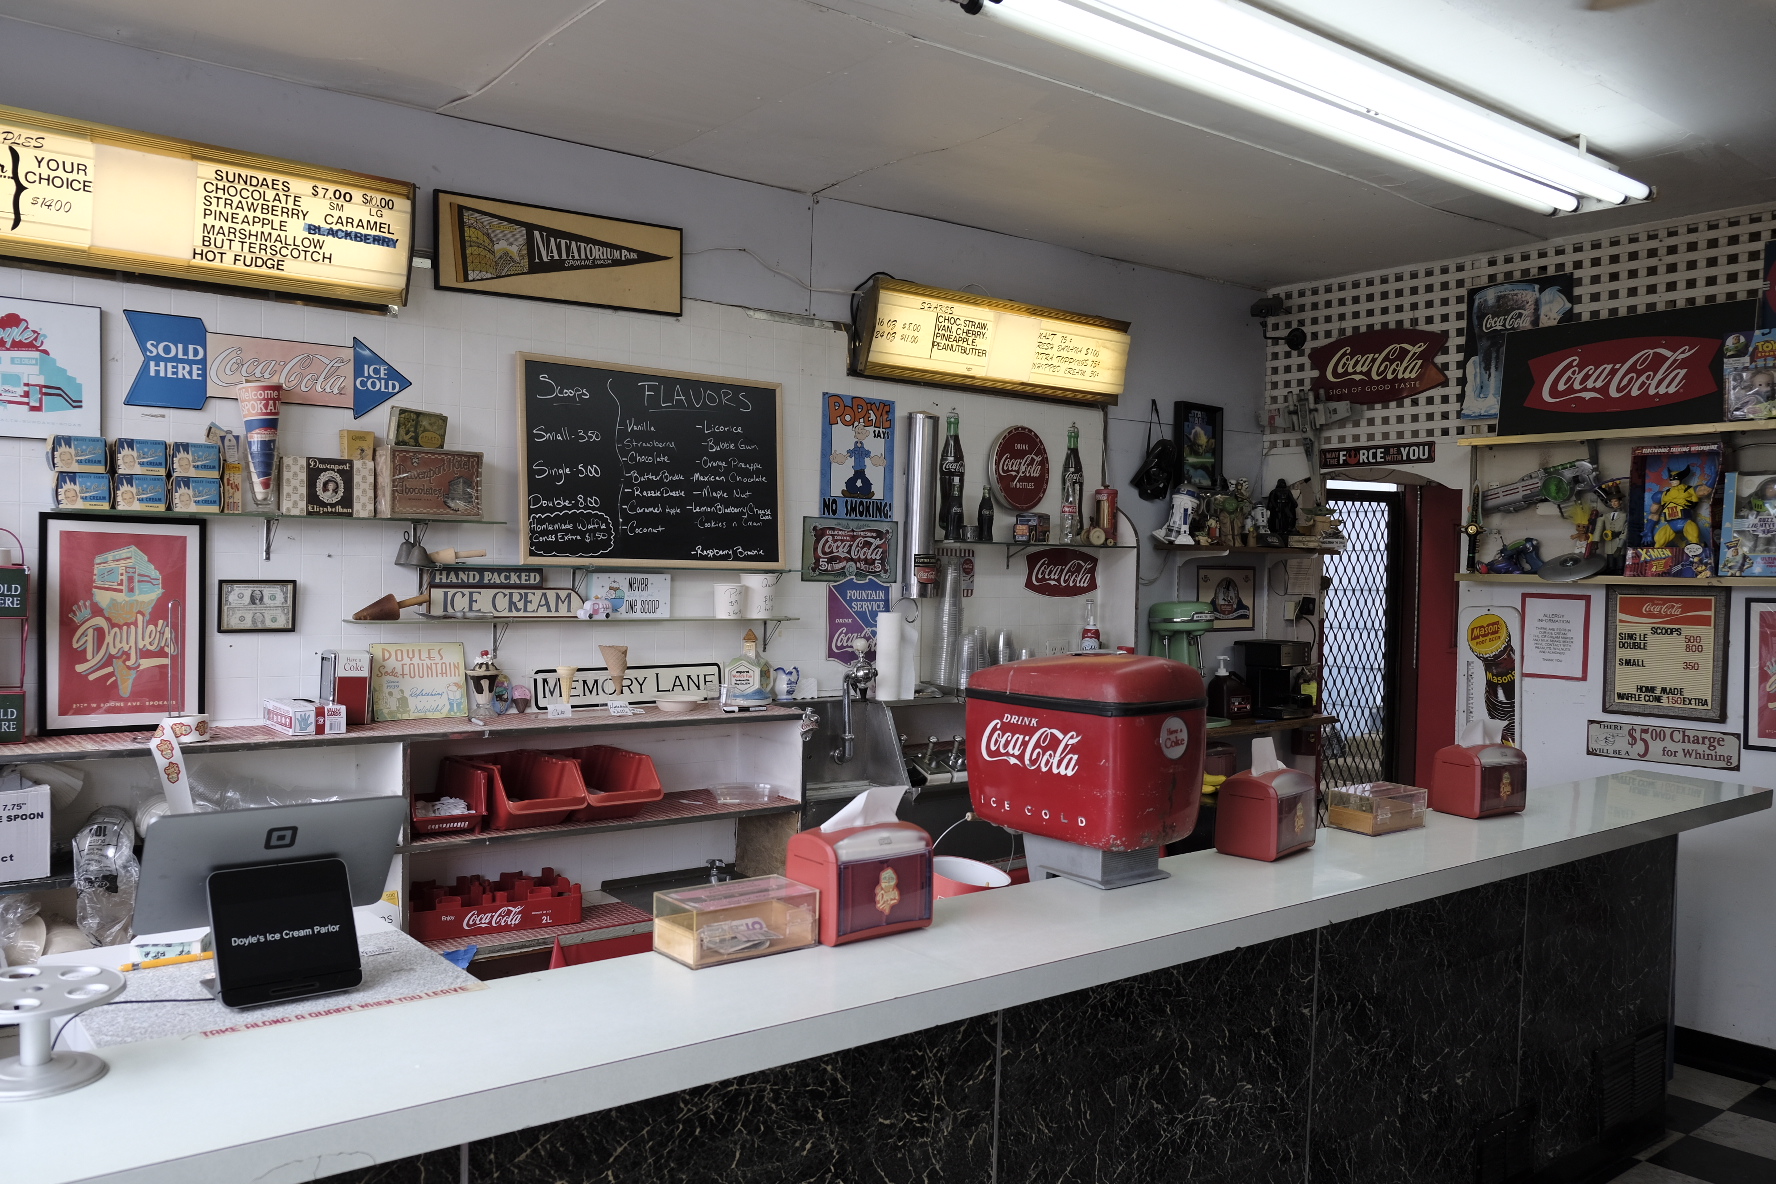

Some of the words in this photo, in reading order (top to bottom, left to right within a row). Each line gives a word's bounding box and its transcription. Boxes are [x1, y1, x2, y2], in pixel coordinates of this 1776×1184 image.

[34, 155, 88, 176] YOUR
[24, 171, 93, 193] CHOICE
[214, 170, 290, 192] SUNDAES
[312, 185, 353, 203] $7.00
[203, 182, 302, 207] CHOCOLATE
[203, 195, 309, 221] STRAWBERRY
[324, 213, 395, 235] CARAMEL
[328, 202, 344, 212] SM
[369, 208, 383, 218] LG
[203, 208, 288, 232] PINEAPPLE
[307, 223, 399, 248] BLACKBERRY
[203, 223, 325, 250] MARSHMALLOW
[202, 236, 333, 263] BUTTERSCOTCH
[533, 230, 621, 262] NATATORIUM
[193, 248, 226, 263] HOT
[233, 254, 285, 271] FUDGE
[877, 317, 884, 327] 16
[1482, 308, 1532, 333] Coca-Cola
[146, 340, 204, 361] SOLD
[933, 341, 988, 357] PEANUTBUTTER
[1326, 342, 1430, 382] Coca-Cola
[150, 361, 203, 381] HERE
[210, 346, 352, 396] Coca-Cola
[364, 364, 388, 377] ICE
[1541, 344, 1701, 403] Coca-Cola
[356, 377, 400, 393] COLD
[536, 374, 590, 401] Scoops
[1365, 384, 1391, 392] GOOD
[1394, 380, 1421, 389] TASTE
[240, 387, 278, 400] Welcome
[638, 382, 752, 411] FLAVORS
[828, 395, 892, 429] POPEYE
[626, 417, 656, 432] Vanilla
[704, 420, 743, 434] Licorice
[533, 426, 570, 442] Small
[873, 429, 890, 439] SAYS
[708, 438, 736, 452] Bubble
[738, 438, 759, 450] Gum
[1014, 443, 1029, 451] DRINK
[1389, 447, 1398, 455] BE
[627, 451, 670, 464] Chocolate
[1400, 446, 1429, 461] YOU
[309, 458, 351, 472] Davenport
[702, 457, 728, 472] Orange
[999, 453, 1043, 478] Coca-Cola
[533, 460, 571, 485] Single
[578, 464, 601, 478] 5.00
[693, 472, 726, 483] Mexican
[729, 472, 767, 483] Chocolate
[634, 486, 661, 497] Razzle
[702, 486, 729, 499] Maple
[733, 489, 753, 498] Nut
[529, 494, 572, 508] Double
[577, 495, 600, 508] 8.00
[627, 500, 663, 514] Caramel
[822, 498, 838, 516] NO
[844, 499, 892, 519] SMOKING!
[577, 517, 607, 531] Waffle
[627, 520, 665, 536] Coconut
[697, 516, 727, 529] Cookies
[558, 532, 581, 542] Extra
[817, 535, 885, 559] Coca-Cola
[1638, 548, 1672, 562] X-MEN
[819, 558, 828, 570] 5
[434, 570, 480, 584] HAND
[483, 572, 540, 585] PACKED
[1032, 557, 1094, 588] Coca-Cola
[442, 590, 482, 614] ICE
[492, 591, 572, 614] CREAM
[846, 590, 885, 600] FOUNTAIN
[852, 601, 885, 611] SERVICE
[1642, 602, 1683, 615] Coca-Cola
[1472, 621, 1502, 638] Mason's
[1651, 626, 1682, 636] SCOOPS
[72, 611, 178, 673] Doyle's
[1619, 641, 1648, 650] DOUBLE
[1685, 644, 1703, 653] 800
[1685, 635, 1702, 644] 500
[381, 647, 445, 662] DOYLES
[343, 662, 365, 673] Coke
[376, 665, 400, 679] Soda
[400, 662, 461, 680] FOUNTAIN
[1619, 658, 1646, 667] SMALL
[1683, 662, 1699, 670] 350
[1486, 670, 1516, 684] Mason's
[542, 676, 648, 699] MEMORY
[1636, 685, 1657, 694] HOME
[1660, 687, 1685, 696] MADE
[1617, 692, 1642, 702] WAFFLE
[1644, 694, 1663, 703] CONE
[1666, 696, 1683, 705] 150
[1682, 697, 1709, 707] EXTRA
[412, 703, 446, 716] Delightful
[1003, 713, 1039, 727] DRINK
[1599, 723, 1624, 731] THERE
[981, 719, 1083, 776] Coca-Cola
[1164, 736, 1185, 749] Coke
[1670, 730, 1726, 751] Charge
[1591, 747, 1611, 755] WILL
[1661, 746, 1679, 758] for
[1681, 748, 1733, 766] Whining
[2, 803, 27, 811] 7.75"
[981, 795, 1011, 810] ICE
[1024, 806, 1086, 827] COLD
[6, 812, 44, 822] SPOON
[1, 854, 14, 862] ct
[463, 905, 525, 930] Coca-Cola
[542, 916, 552, 924] 2L
[231, 934, 265, 947] Doyle's
[266, 932, 280, 941] Ice
[282, 928, 312, 939] Cream
[314, 923, 340, 935] Parlor
[202, 1026, 240, 1038] TAKE
[245, 1016, 292, 1031] ALONG
[308, 1006, 353, 1018] QUART
[357, 999, 394, 1009] WHEN
[397, 994, 423, 1003] YOU
[425, 985, 469, 999] LEAVE
